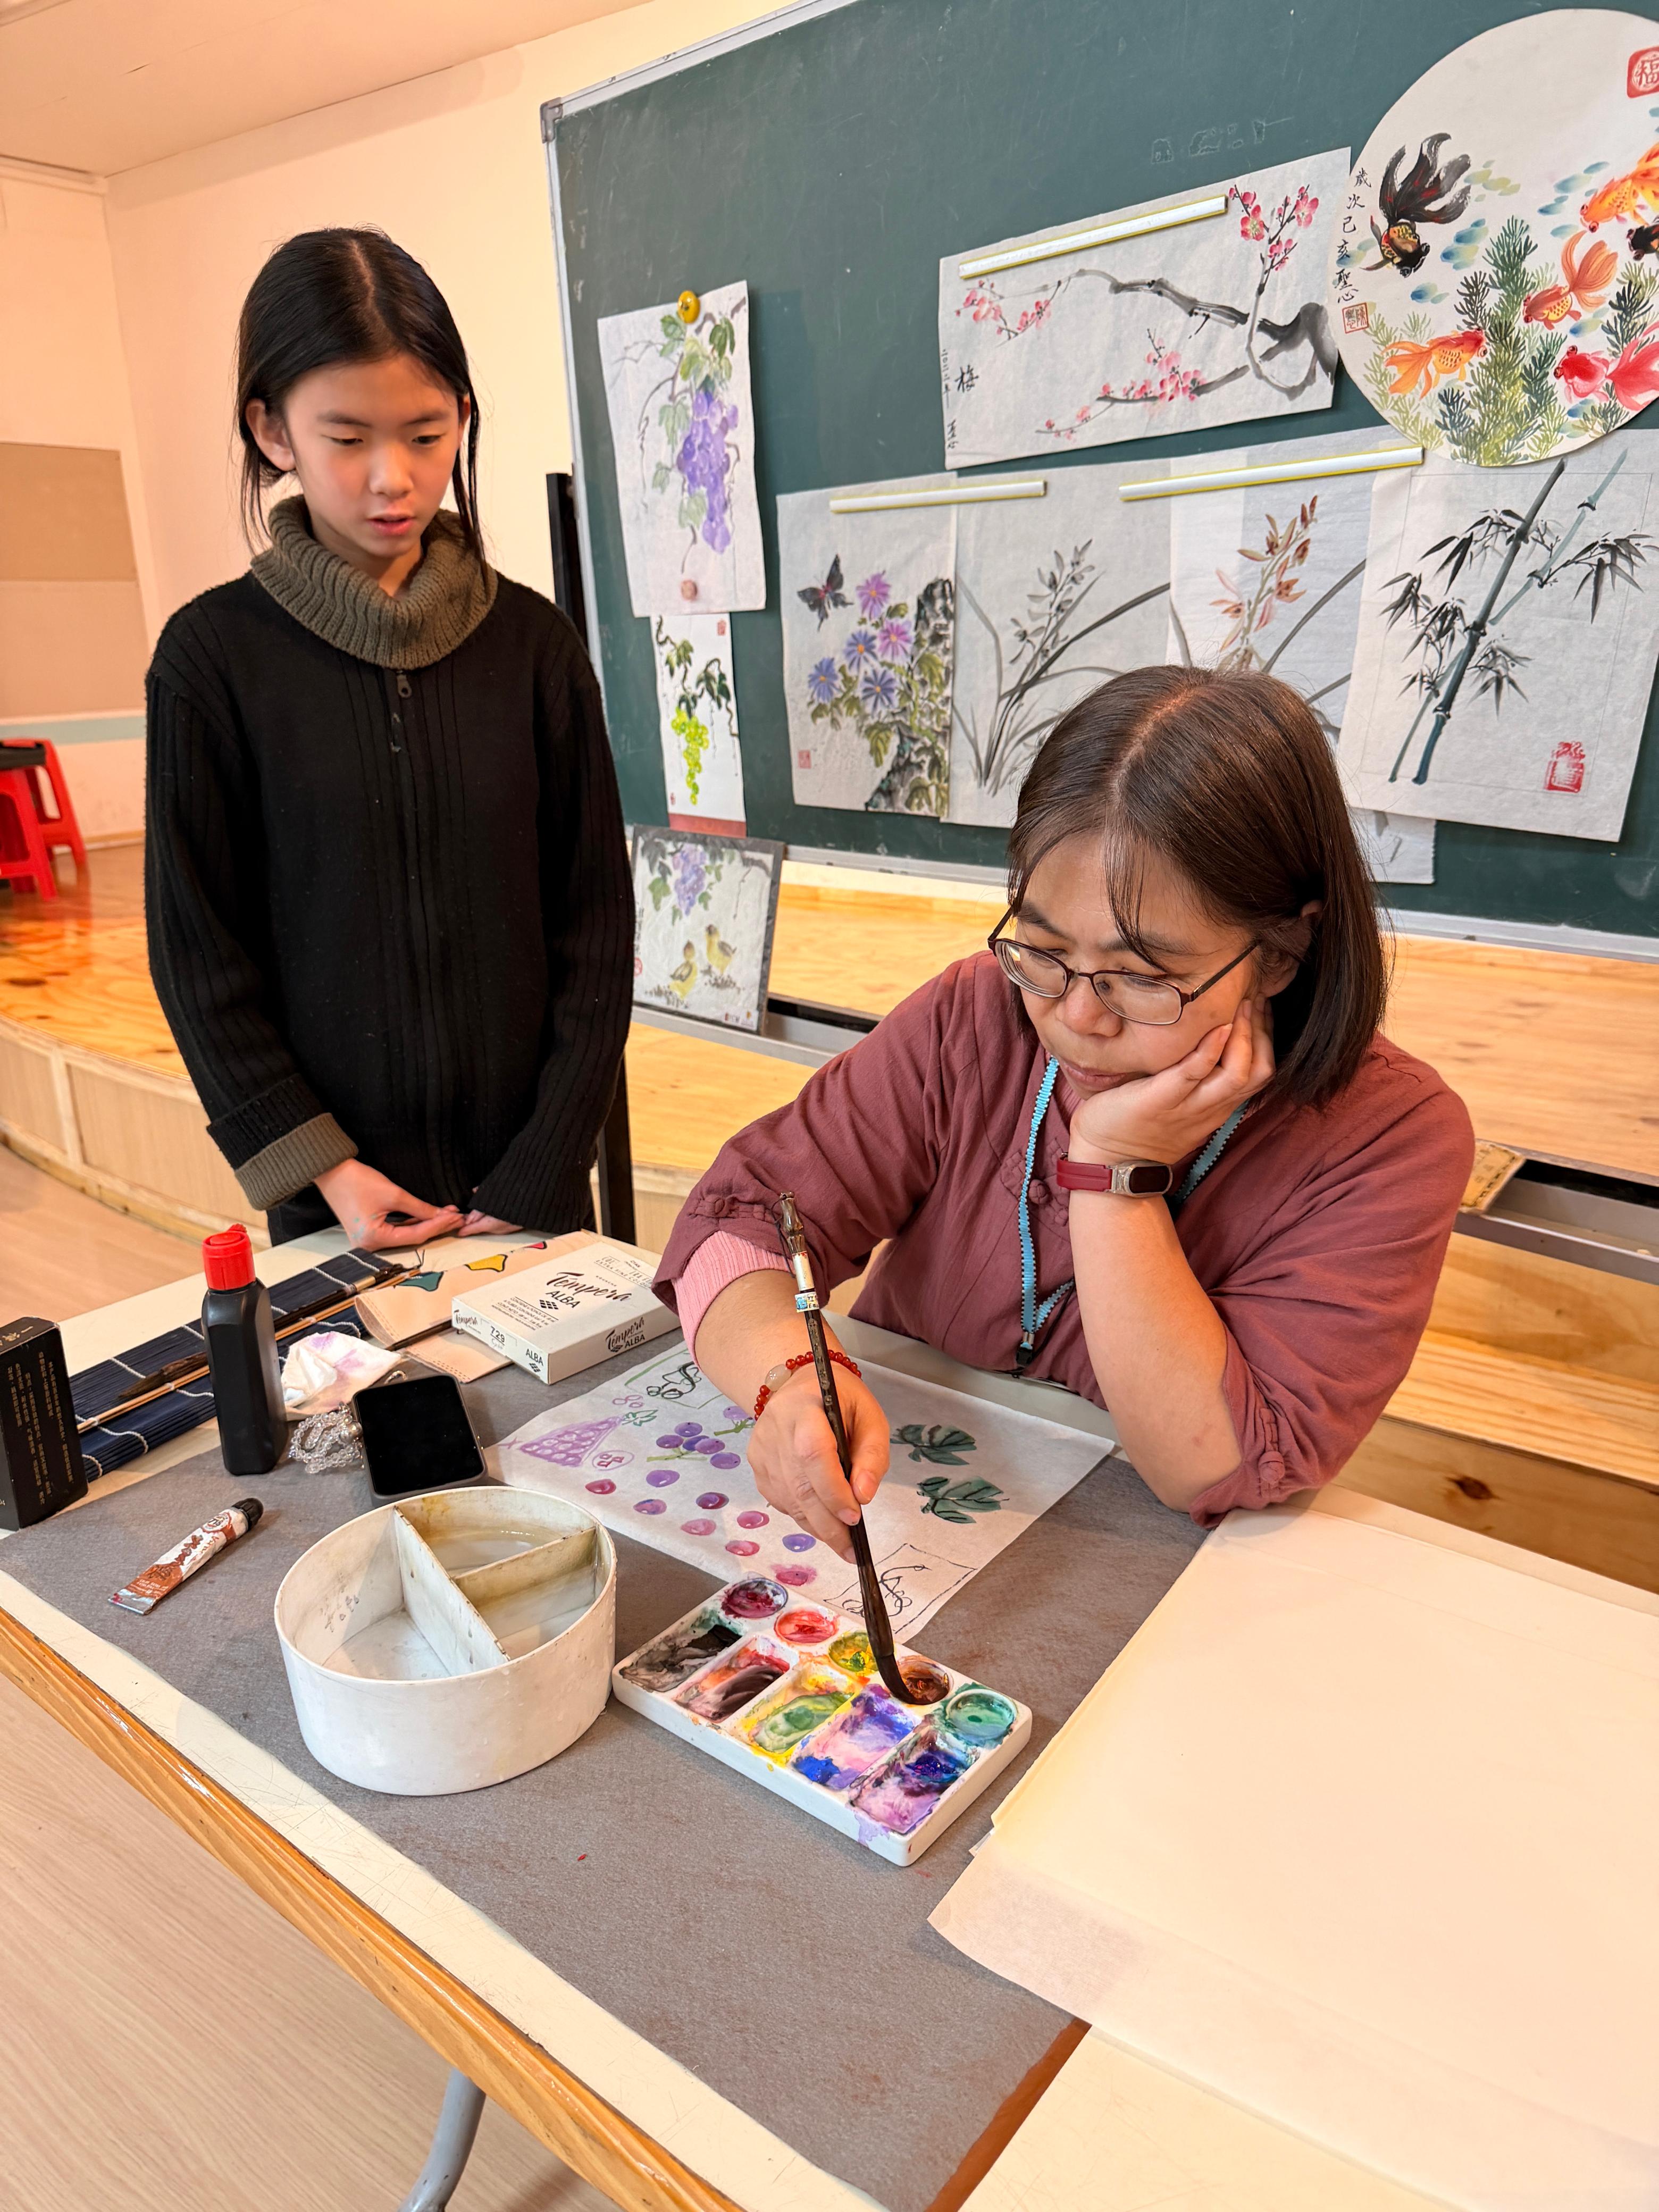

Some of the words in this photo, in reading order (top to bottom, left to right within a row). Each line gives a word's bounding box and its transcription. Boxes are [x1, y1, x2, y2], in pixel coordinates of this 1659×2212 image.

[546, 1290, 581, 1309] ALBA
[490, 1325, 506, 1343] 729
[624, 1334, 646, 1349] ALBA
[525, 1348, 544, 1367] ALBA
